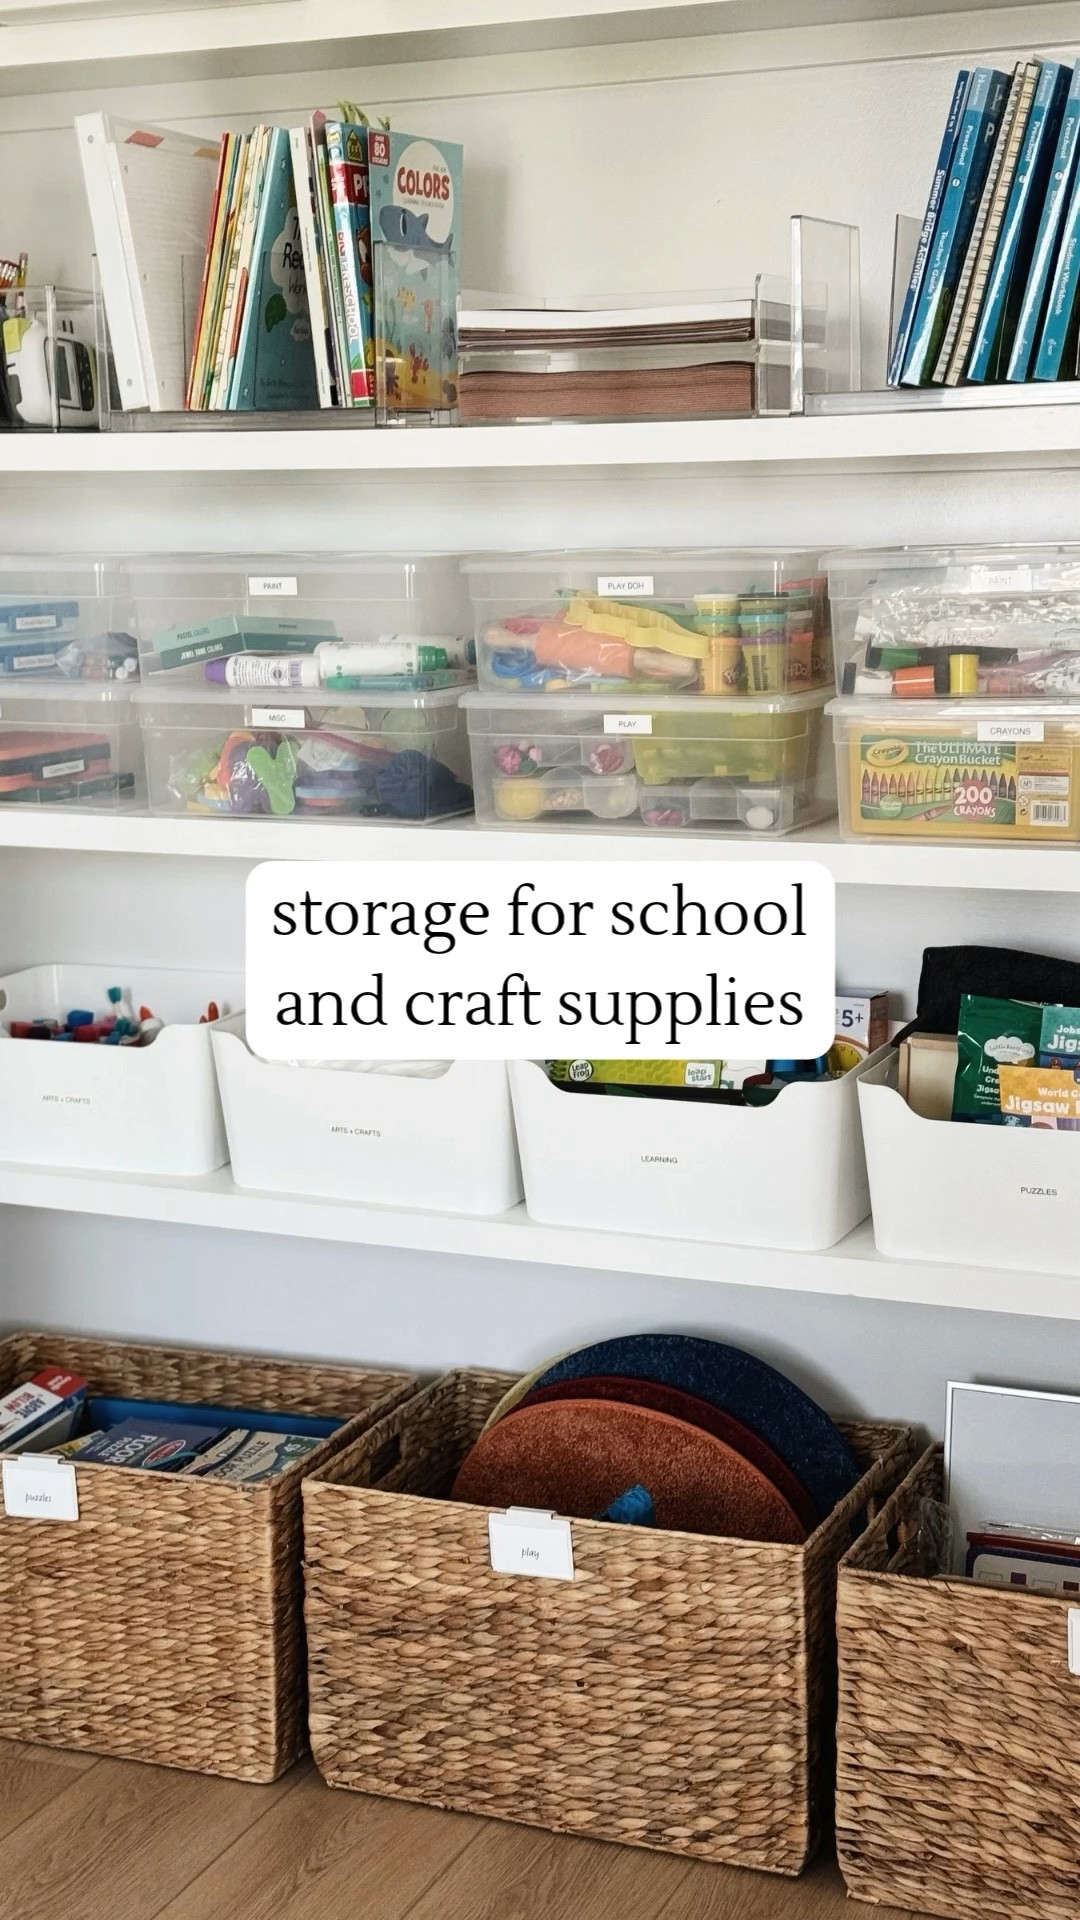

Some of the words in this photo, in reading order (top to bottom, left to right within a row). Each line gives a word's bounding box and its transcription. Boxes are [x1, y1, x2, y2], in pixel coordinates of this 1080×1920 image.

[956, 124, 974, 166] Preschool
[1024, 120, 1040, 162] Preschool
[1058, 116, 1075, 159] Preschool
[373, 142, 386, 158] 80
[397, 166, 450, 201] COLORS
[927, 168, 946, 211] Summer
[919, 210, 936, 244] Bridge
[932, 228, 949, 268] Teacher's
[1063, 236, 1077, 271] Student
[910, 244, 928, 290] Activities
[926, 268, 939, 294] Guide
[341, 256, 360, 343] PRESCHOOL
[1053, 270, 1071, 316] Workbook
[263, 582, 282, 590] PAINT
[607, 582, 626, 590] PLAY
[627, 582, 645, 590] DOH
[988, 576, 1014, 586] PAINT
[268, 714, 286, 722] MISC
[618, 720, 637, 728] PLAY
[990, 727, 1032, 736] CRAYONS
[915, 741, 938, 754] The
[938, 742, 1001, 755] ULTIMATE
[915, 754, 958, 767] Crayon
[959, 754, 1001, 766] Bucket
[954, 786, 993, 805] 200
[954, 805, 996, 818] CRAYONS
[841, 1009, 864, 1028] 5+
[691, 1073, 711, 1082] start
[1038, 1087, 1069, 1098] World
[65, 1096, 91, 1105] CRAFTS
[1004, 1095, 1070, 1114] Jigsaw
[331, 1126, 348, 1134] ARTS
[354, 1128, 382, 1138] CRAFTS
[640, 1155, 678, 1165] LEARNING
[1020, 1186, 1058, 1197] PUZZLES
[106, 1434, 158, 1464] FLOOR
[25, 1492, 52, 1503] puzzles
[521, 1548, 540, 1560] play
